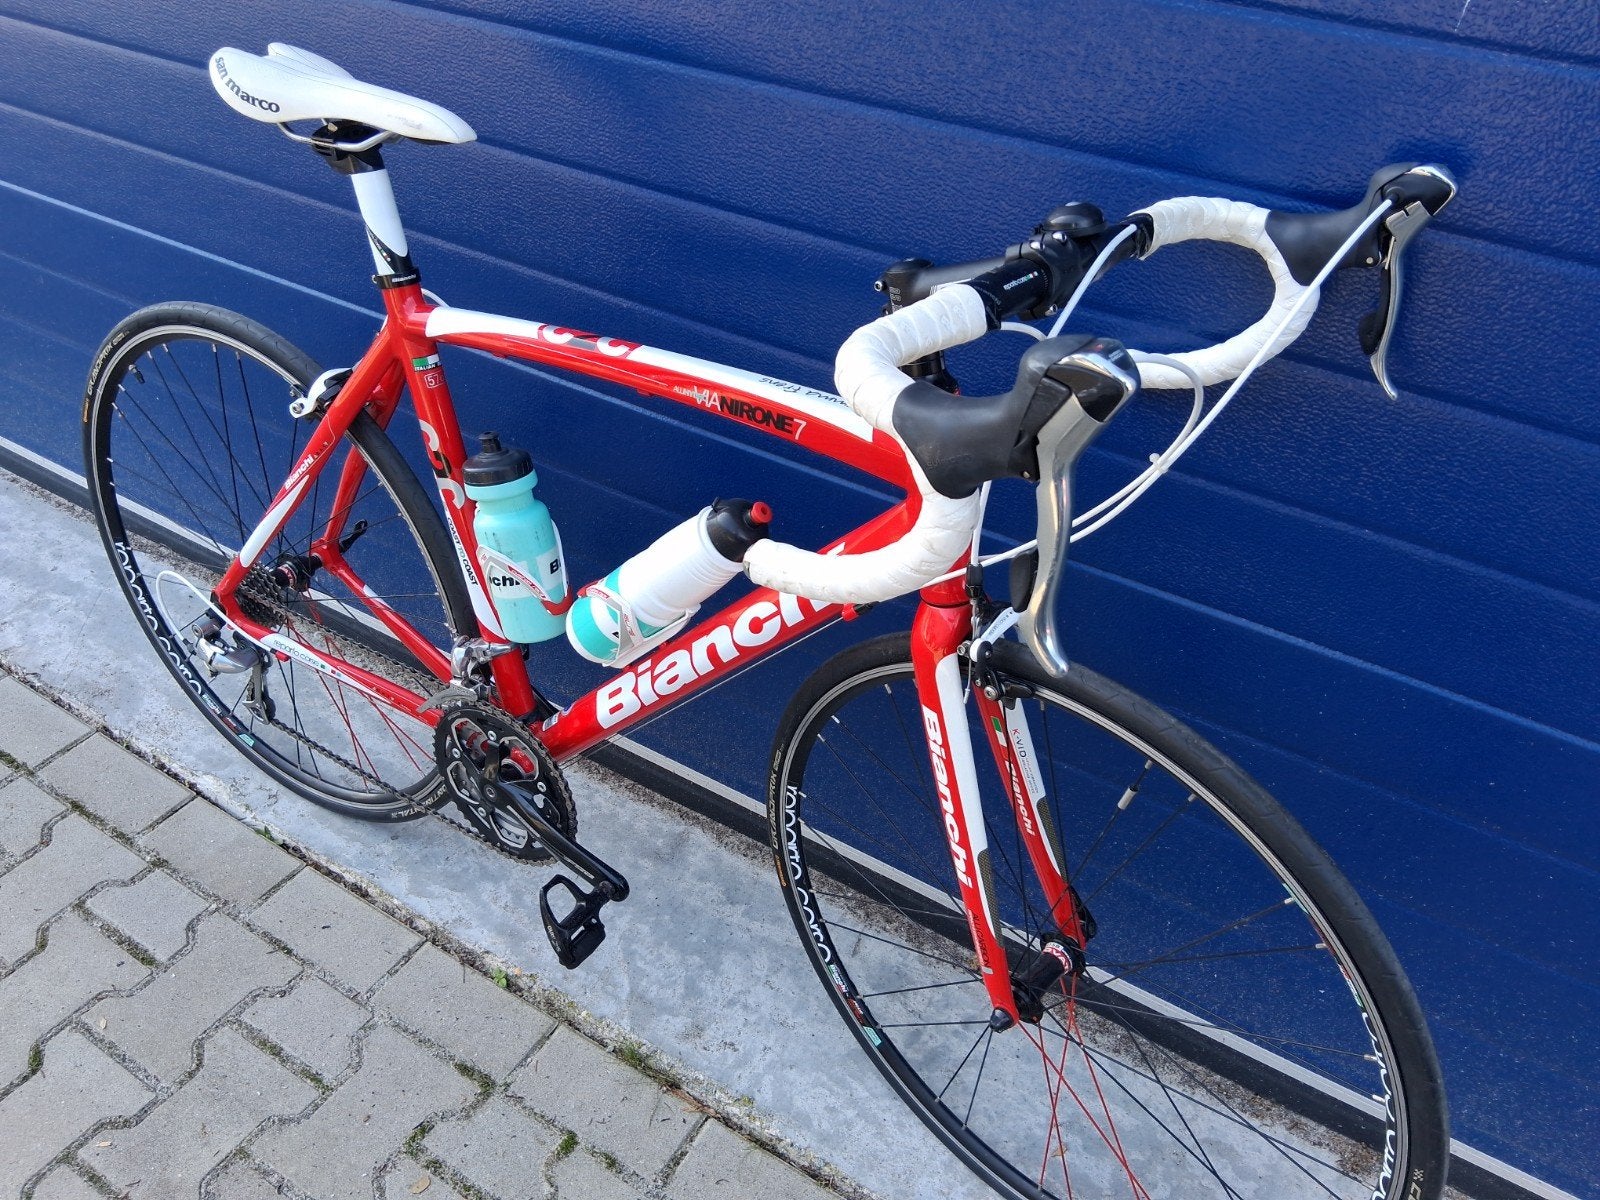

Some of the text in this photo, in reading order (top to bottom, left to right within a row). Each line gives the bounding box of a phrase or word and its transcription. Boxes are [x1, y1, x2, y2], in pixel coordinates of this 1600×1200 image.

[214, 56, 281, 114] san marco
[720, 395, 795, 435] NIRONE
[283, 455, 314, 491] Bianchi
[463, 558, 479, 587] COAST
[595, 541, 846, 729] Bianch
[1011, 728, 1027, 758] K-VID
[921, 704, 974, 892] Bianchi
